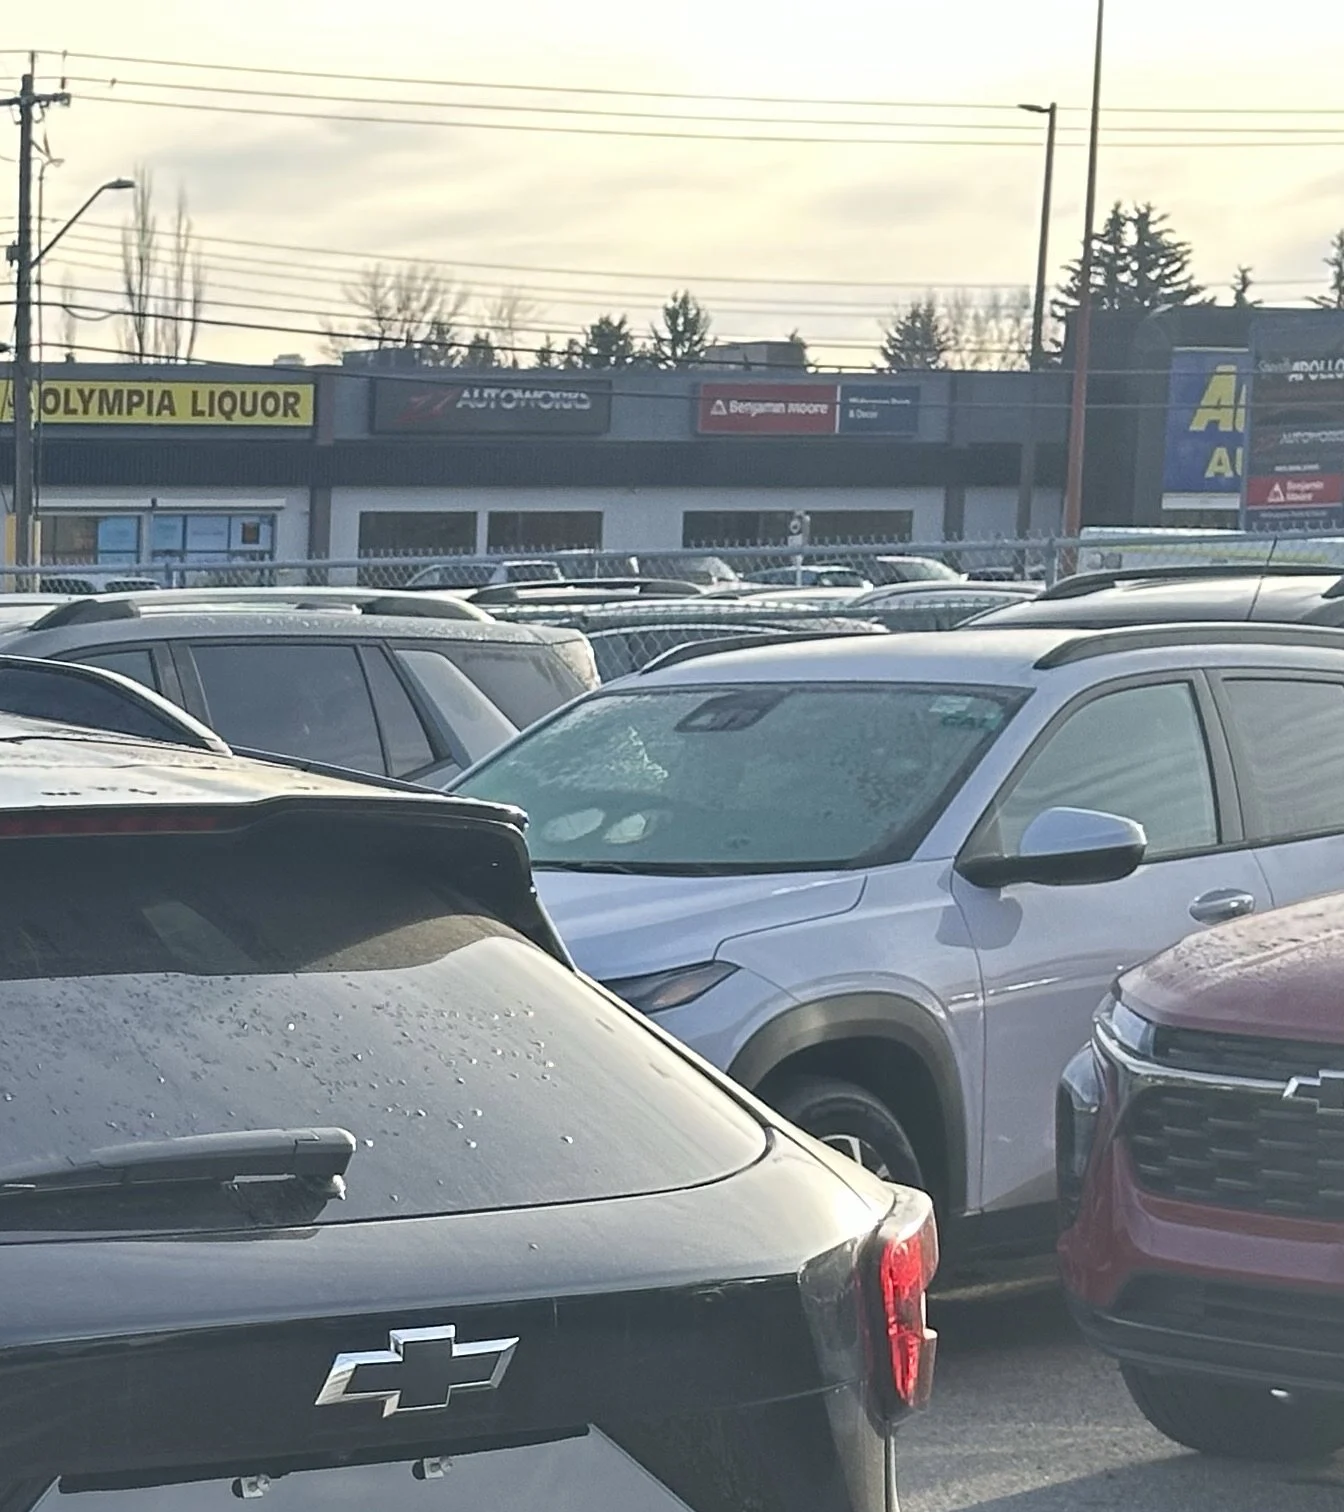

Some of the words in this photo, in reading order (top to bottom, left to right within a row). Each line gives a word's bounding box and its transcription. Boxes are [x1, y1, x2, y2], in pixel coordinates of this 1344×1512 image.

[41, 387, 177, 418] OLYMPIA
[191, 390, 302, 421] LIQUOR
[456, 387, 592, 410] AUTOWORKS
[729, 400, 786, 417] Benjamin
